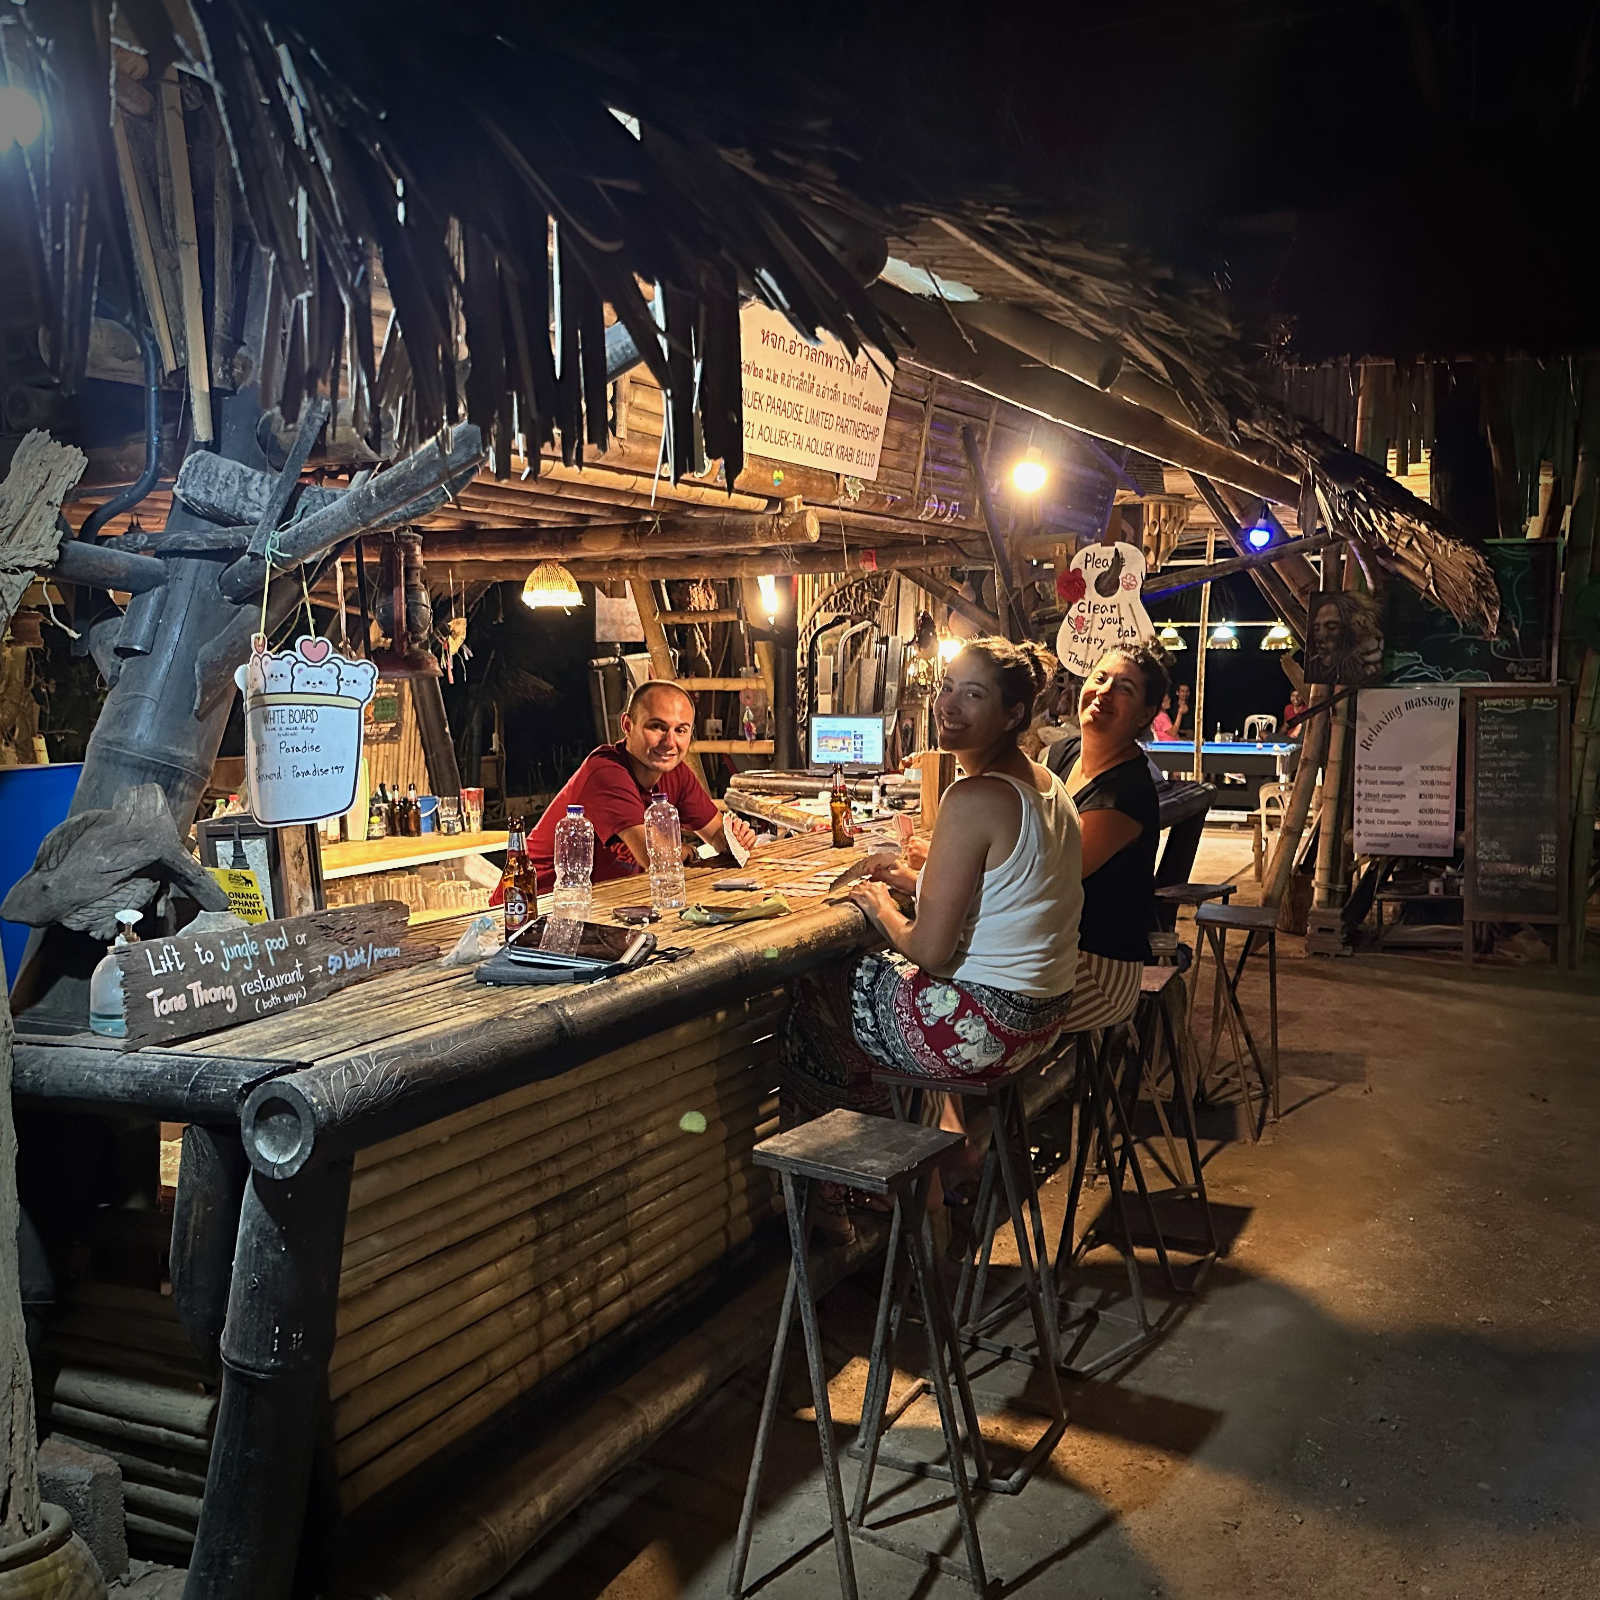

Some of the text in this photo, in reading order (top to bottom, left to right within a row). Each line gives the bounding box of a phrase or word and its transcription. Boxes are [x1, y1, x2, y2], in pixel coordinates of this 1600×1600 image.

[742, 388, 880, 443] LUEK PARADISE LIMITED PARTNERSHIP
[757, 423, 804, 452] AOLUEK-TAI
[805, 436, 834, 458] AOLUEK
[835, 444, 855, 463] KRABI
[855, 449, 876, 468] 81110
[1077, 600, 1117, 614] Clear
[1098, 617, 1124, 630] your
[1117, 626, 1137, 638] tab
[1072, 634, 1105, 650] every
[263, 708, 319, 725] WHITE BOARD
[1360, 696, 1454, 751] Relaxing massage
[279, 740, 321, 755] Paradise
[228, 891, 260, 901] ONANG
[507, 902, 527, 915] EO
[145, 925, 308, 976] Lift to jungle pool or
[240, 959, 305, 996] restaurant
[254, 998, 282, 1014] (both
